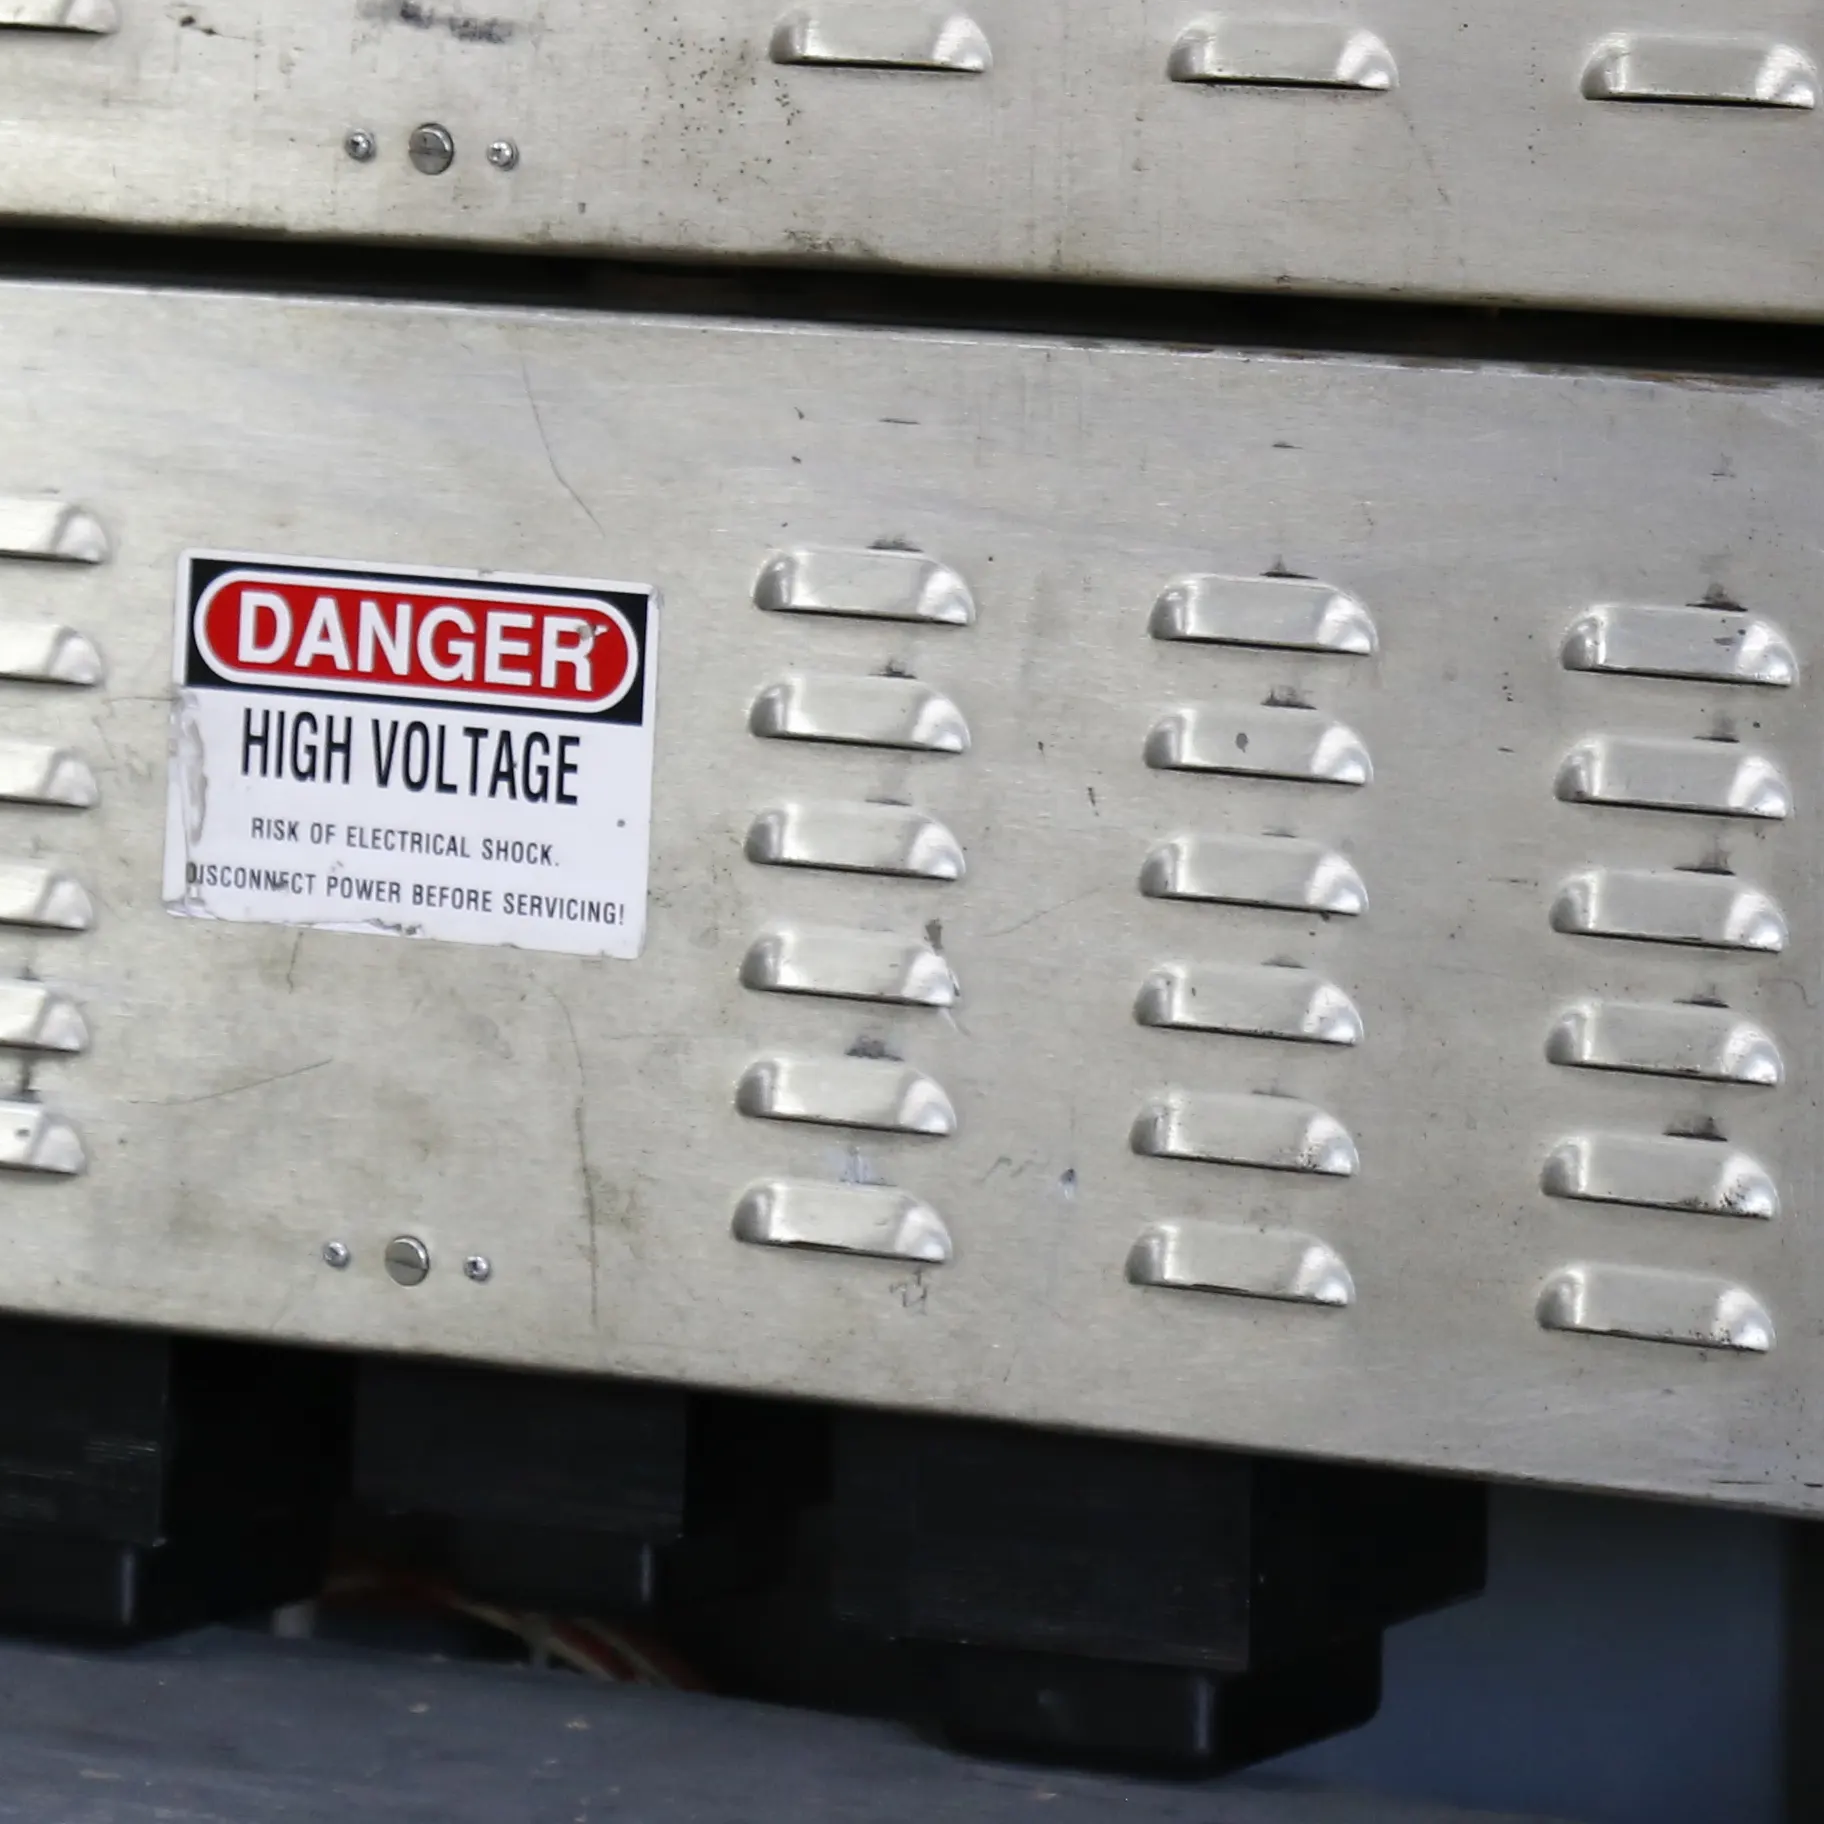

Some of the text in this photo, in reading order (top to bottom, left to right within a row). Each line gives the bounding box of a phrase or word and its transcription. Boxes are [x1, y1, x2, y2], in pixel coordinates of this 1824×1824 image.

[237, 589, 595, 692] DANGER
[241, 707, 581, 806] HIGH VOLTAGE
[251, 817, 561, 867] RISK OF ELECTRICAL SHOCK.
[326, 875, 402, 905] POWER
[411, 884, 493, 914] BEFORE
[502, 892, 625, 926] SERVICING!
